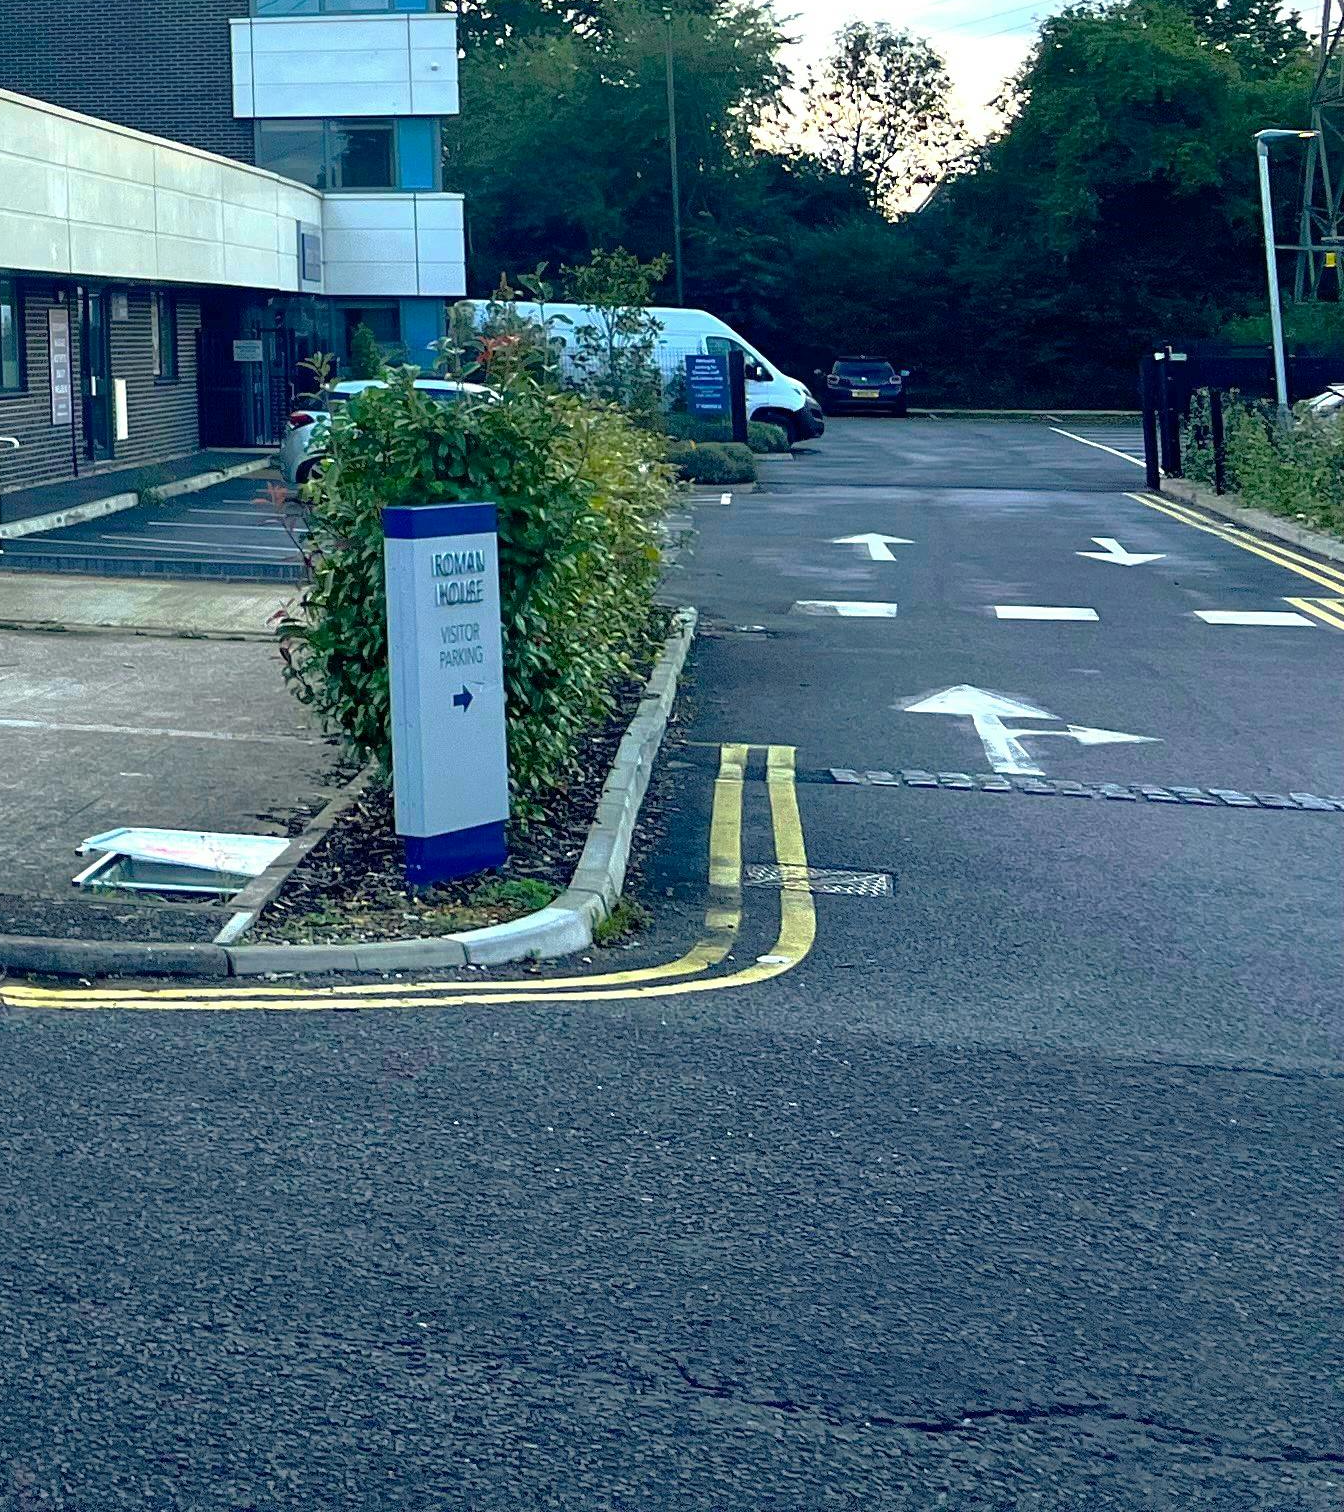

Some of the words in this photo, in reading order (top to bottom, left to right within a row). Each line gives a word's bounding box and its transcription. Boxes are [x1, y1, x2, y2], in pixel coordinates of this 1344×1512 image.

[431, 549, 485, 577] ROMAN
[434, 579, 484, 606] HOUSE
[440, 623, 481, 644] VISITOR
[439, 645, 484, 668] PARKING
